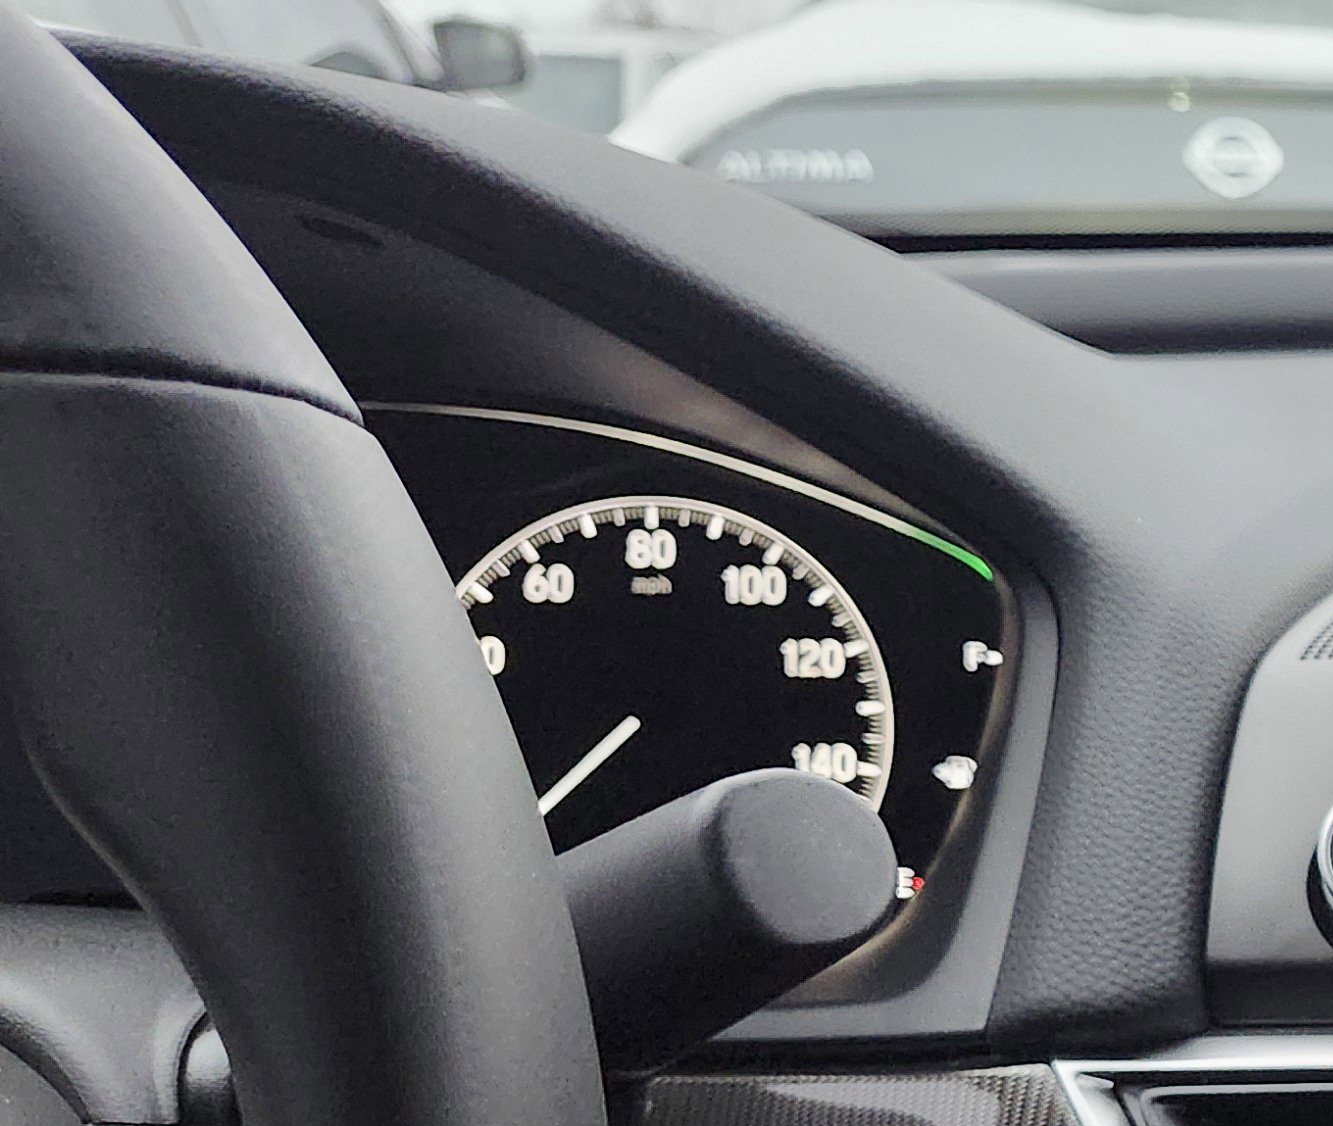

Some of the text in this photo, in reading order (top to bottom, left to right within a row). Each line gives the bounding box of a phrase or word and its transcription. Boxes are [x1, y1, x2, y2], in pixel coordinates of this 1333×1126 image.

[625, 529, 676, 569] 80
[522, 563, 574, 603] 60
[721, 564, 788, 605] 100
[479, 636, 506, 676] 0
[780, 638, 845, 678] 120
[963, 641, 986, 671] F
[793, 742, 858, 784] 140
